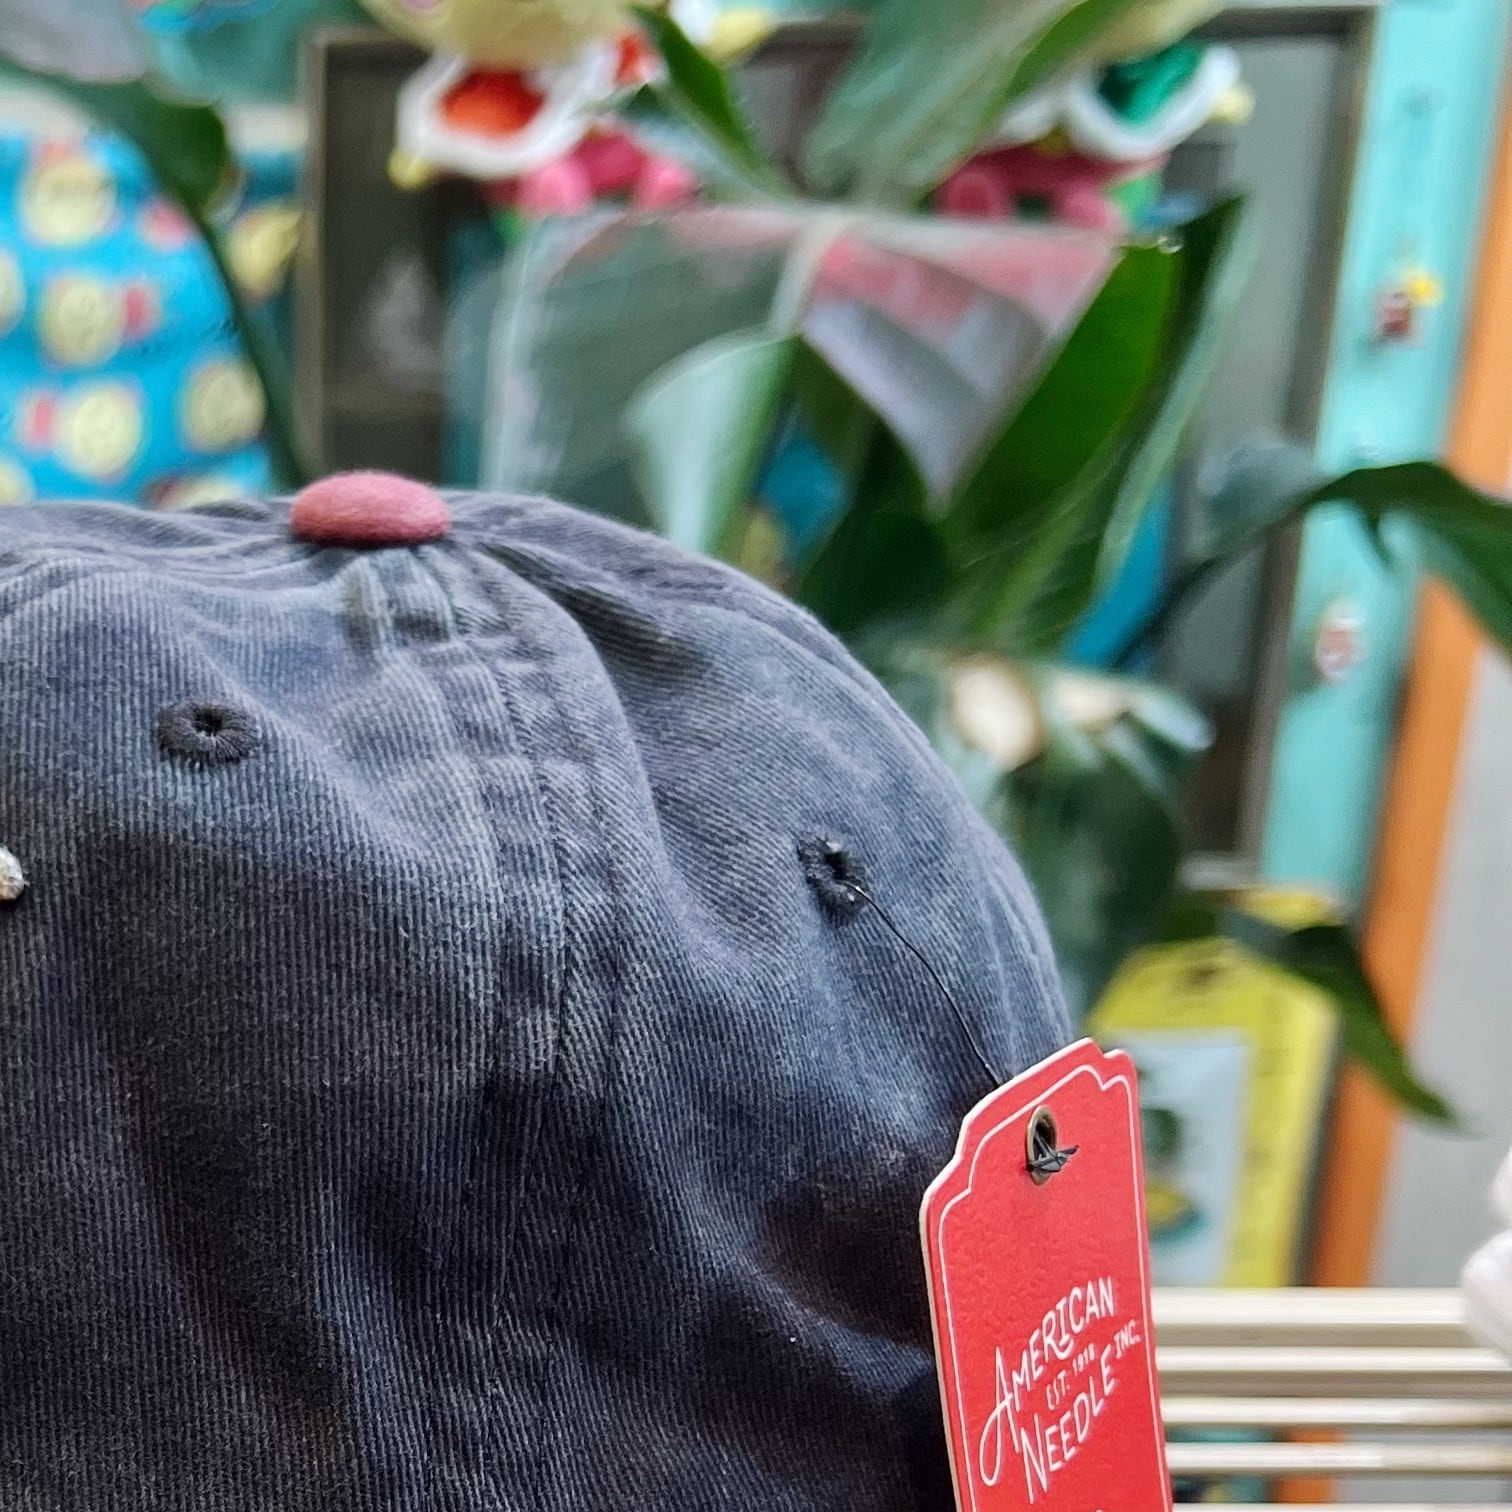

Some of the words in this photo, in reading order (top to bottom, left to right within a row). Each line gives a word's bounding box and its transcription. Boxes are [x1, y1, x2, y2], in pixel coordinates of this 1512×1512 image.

[979, 1276, 1115, 1486] AMERICAN
[1113, 1319, 1141, 1359] INC.
[1020, 1344, 1116, 1504] NEEDLE
[1046, 1369, 1071, 1411] EST.
